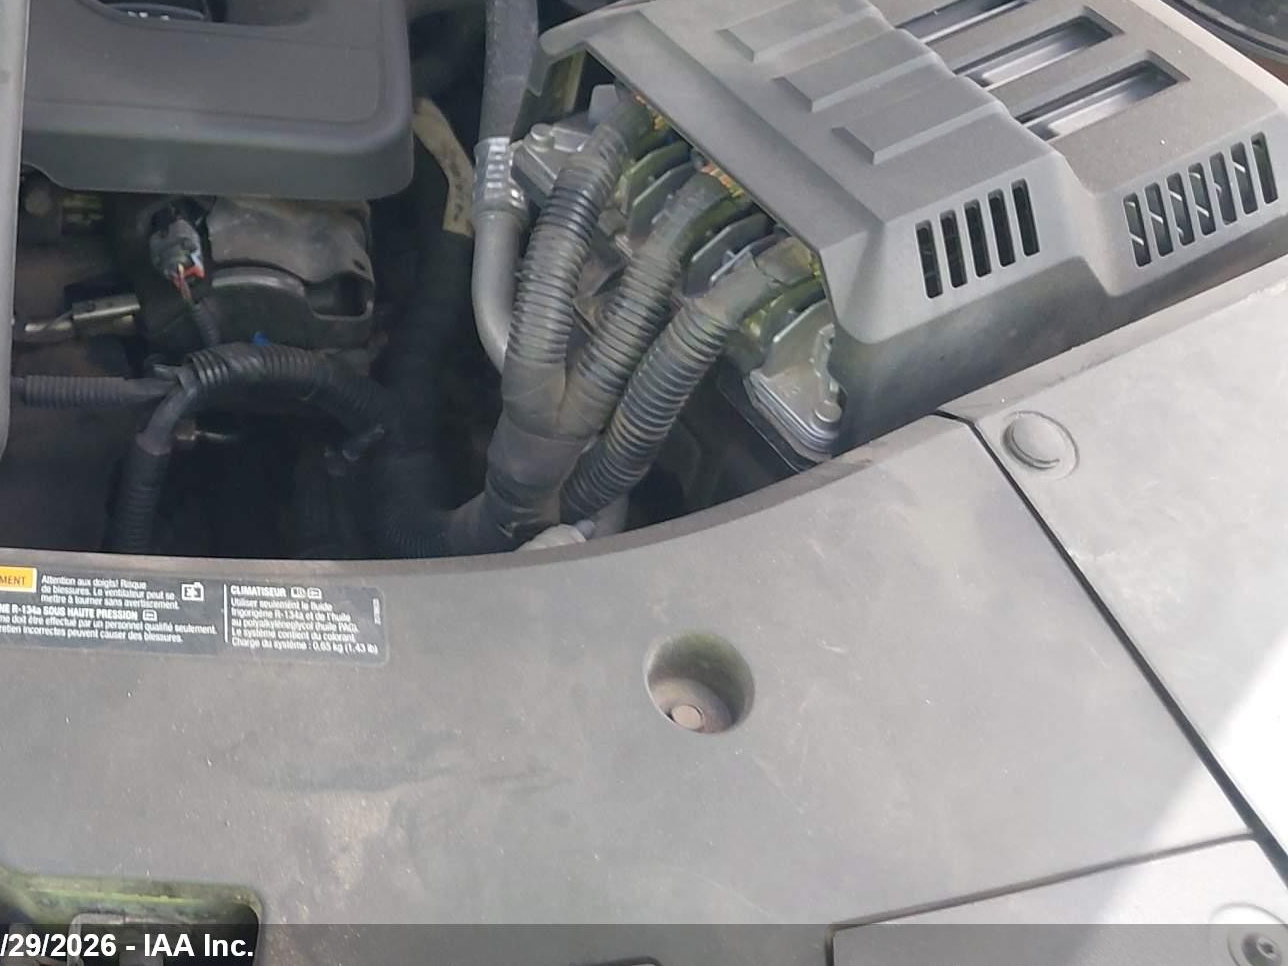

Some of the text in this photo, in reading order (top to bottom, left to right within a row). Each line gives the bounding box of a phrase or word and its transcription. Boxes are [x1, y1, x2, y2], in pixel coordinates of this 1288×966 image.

[42, 575, 76, 585] Attention
[76, 578, 92, 586] aux
[120, 579, 147, 590] Risque
[41, 585, 51, 593] de
[93, 588, 103, 596] Le
[104, 588, 145, 598] ventilateur
[146, 590, 164, 600] peut
[165, 592, 175, 600] se
[230, 586, 287, 597] CLIMATISEUR
[40, 594, 67, 604] mettre
[74, 596, 103, 605] tourner
[103, 598, 123, 606] sans
[232, 598, 259, 607] Utiliser
[259, 599, 301, 609] seulement
[12, 604, 42, 615] R-134a
[42, 605, 66, 616] SOUS
[67, 607, 95, 617] HAUTE
[96, 608, 138, 619] PRESSION
[12, 615, 26, 624] doit
[78, 619, 92, 628] par
[93, 620, 103, 628] un
[104, 620, 143, 631] personnel
[23, 625, 66, 636] incorrectes
[68, 628, 99, 638] peuvent
[100, 630, 126, 639] causer
[128, 631, 143, 640] des
